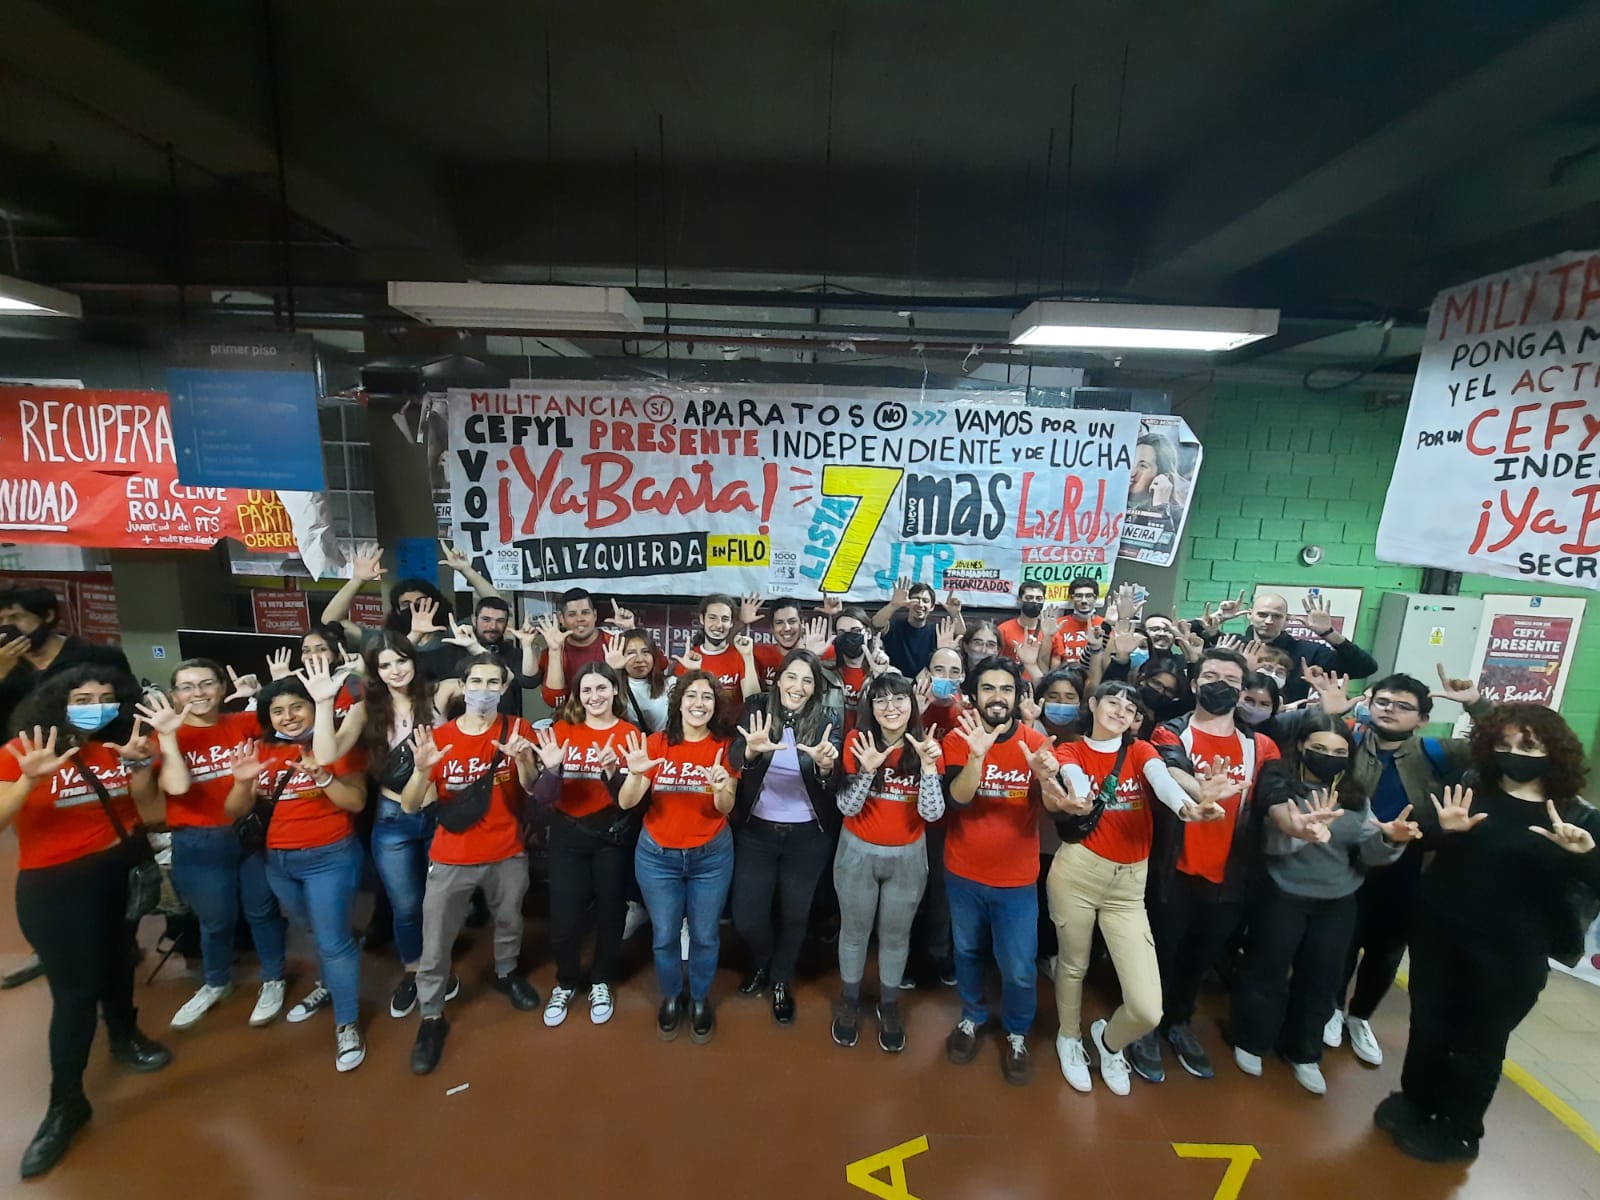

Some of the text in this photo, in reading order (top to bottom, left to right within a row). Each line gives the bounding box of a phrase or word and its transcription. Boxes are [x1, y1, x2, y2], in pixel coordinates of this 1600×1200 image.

[1440, 255, 1600, 341] MILITA
[210, 343, 278, 357] primer piso
[1511, 361, 1600, 395] ACTI
[470, 391, 638, 418] MILITANCIA
[683, 398, 865, 428] APARATOS
[954, 408, 1034, 438] VAMOS
[1041, 419, 1078, 434] POR
[1088, 422, 1115, 440] UN
[464, 414, 574, 448] CEFYL
[773, 429, 1003, 465] INDEPENDIENTE
[1049, 437, 1132, 472] LUCHA
[1417, 430, 1444, 451] POR
[1446, 428, 1464, 443] UN
[1493, 453, 1600, 482] INDE
[126, 477, 159, 499] EN
[0, 479, 78, 523] NIDAD
[128, 499, 188, 523] ROJA
[902, 472, 1012, 541] nuevo mas
[195, 516, 220, 533] PTS
[236, 504, 293, 534] PARTI
[799, 464, 905, 594] LISTA 7
[727, 539, 766, 563] FILO
[774, 553, 797, 561] 1000
[873, 543, 956, 591] JTP
[1519, 552, 1597, 578] SECR
[1492, 638, 1562, 652] PRESENTE
[1513, 628, 1546, 638] CEFYL
[1503, 685, 1552, 702] Basta!
[985, 764, 1032, 784] Basta!
